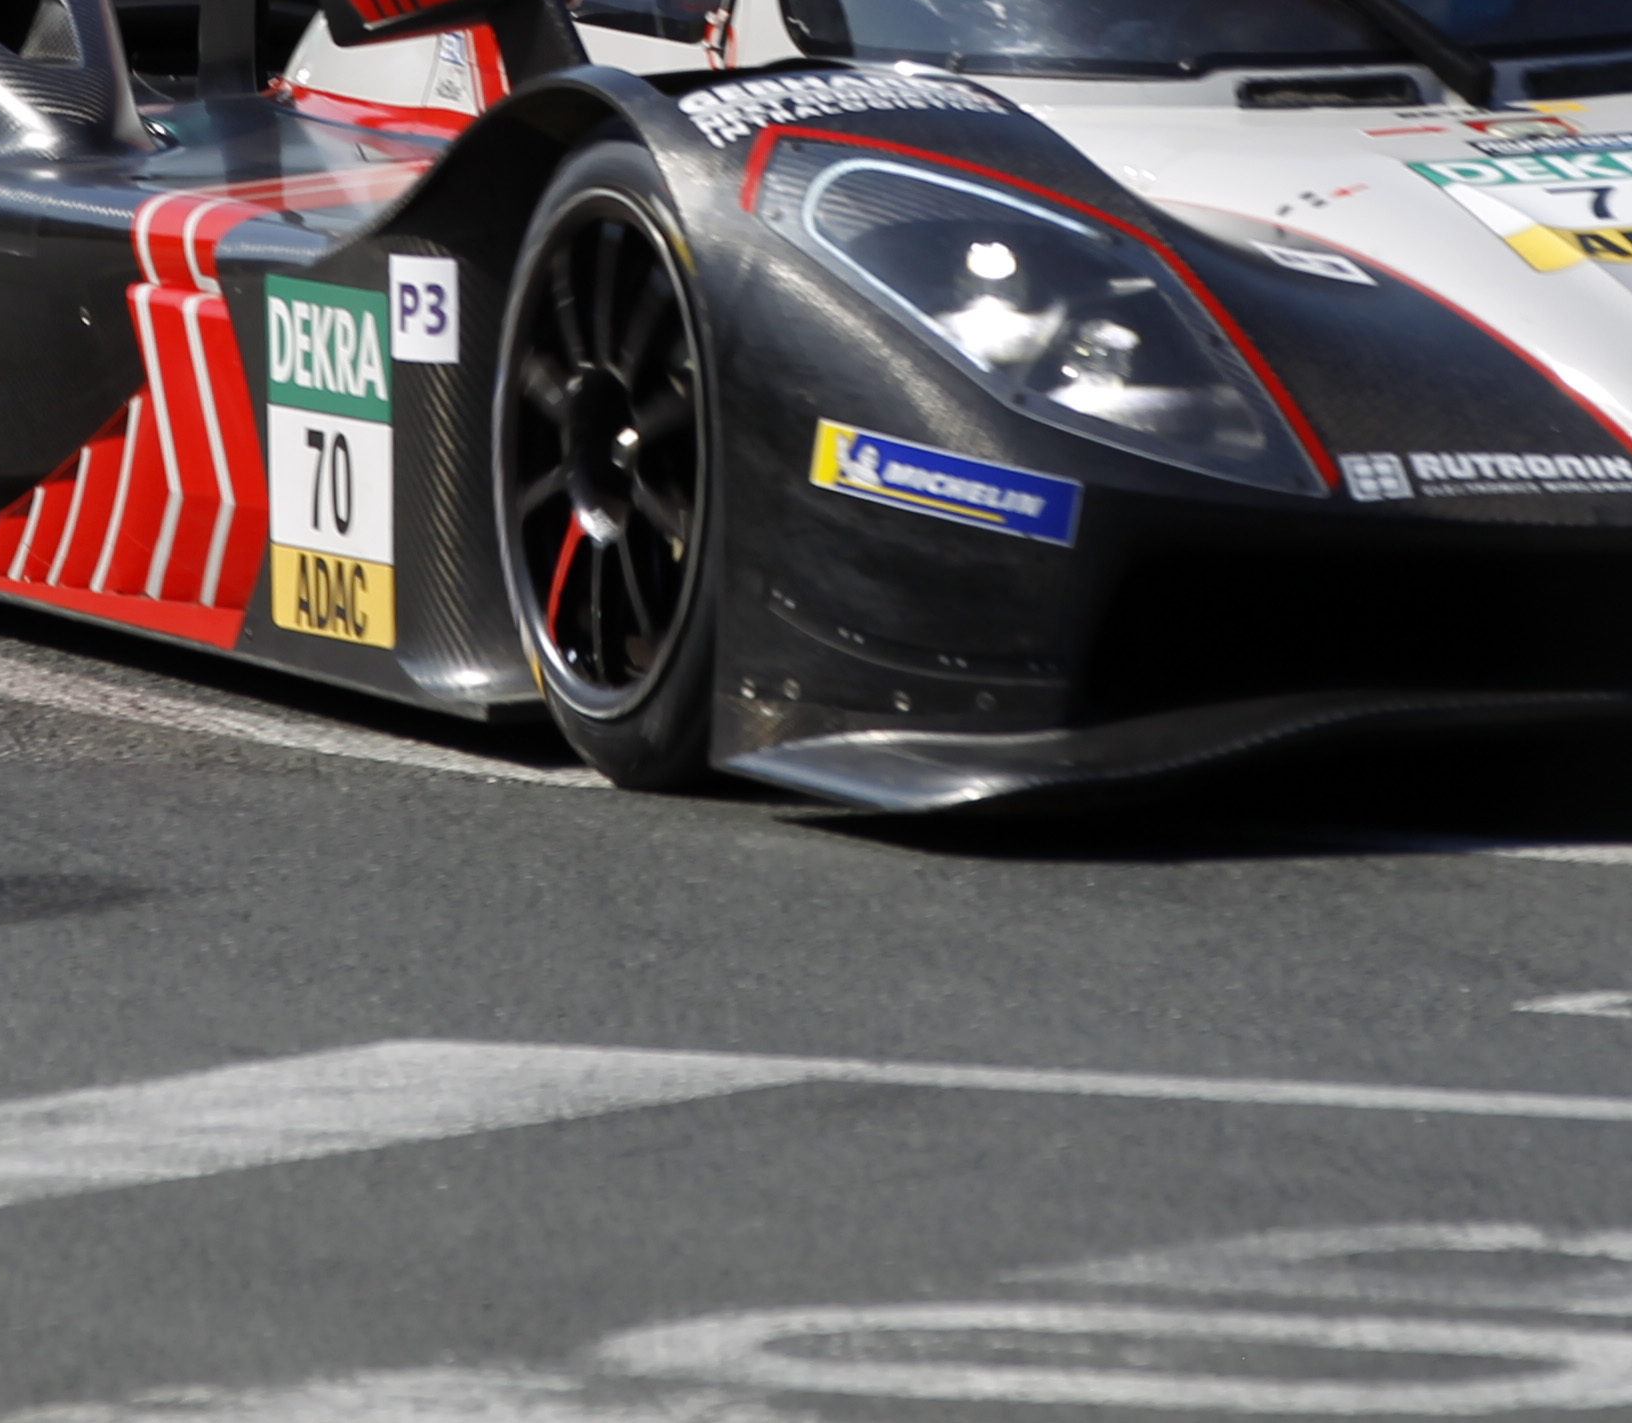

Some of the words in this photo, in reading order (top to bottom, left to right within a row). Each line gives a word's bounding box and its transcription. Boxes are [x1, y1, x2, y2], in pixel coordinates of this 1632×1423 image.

[268, 296, 388, 402] DEKRA
[398, 282, 448, 337] P3
[305, 428, 353, 535] 70
[882, 460, 1047, 519] MICHELIN
[295, 552, 368, 641] ADAC
